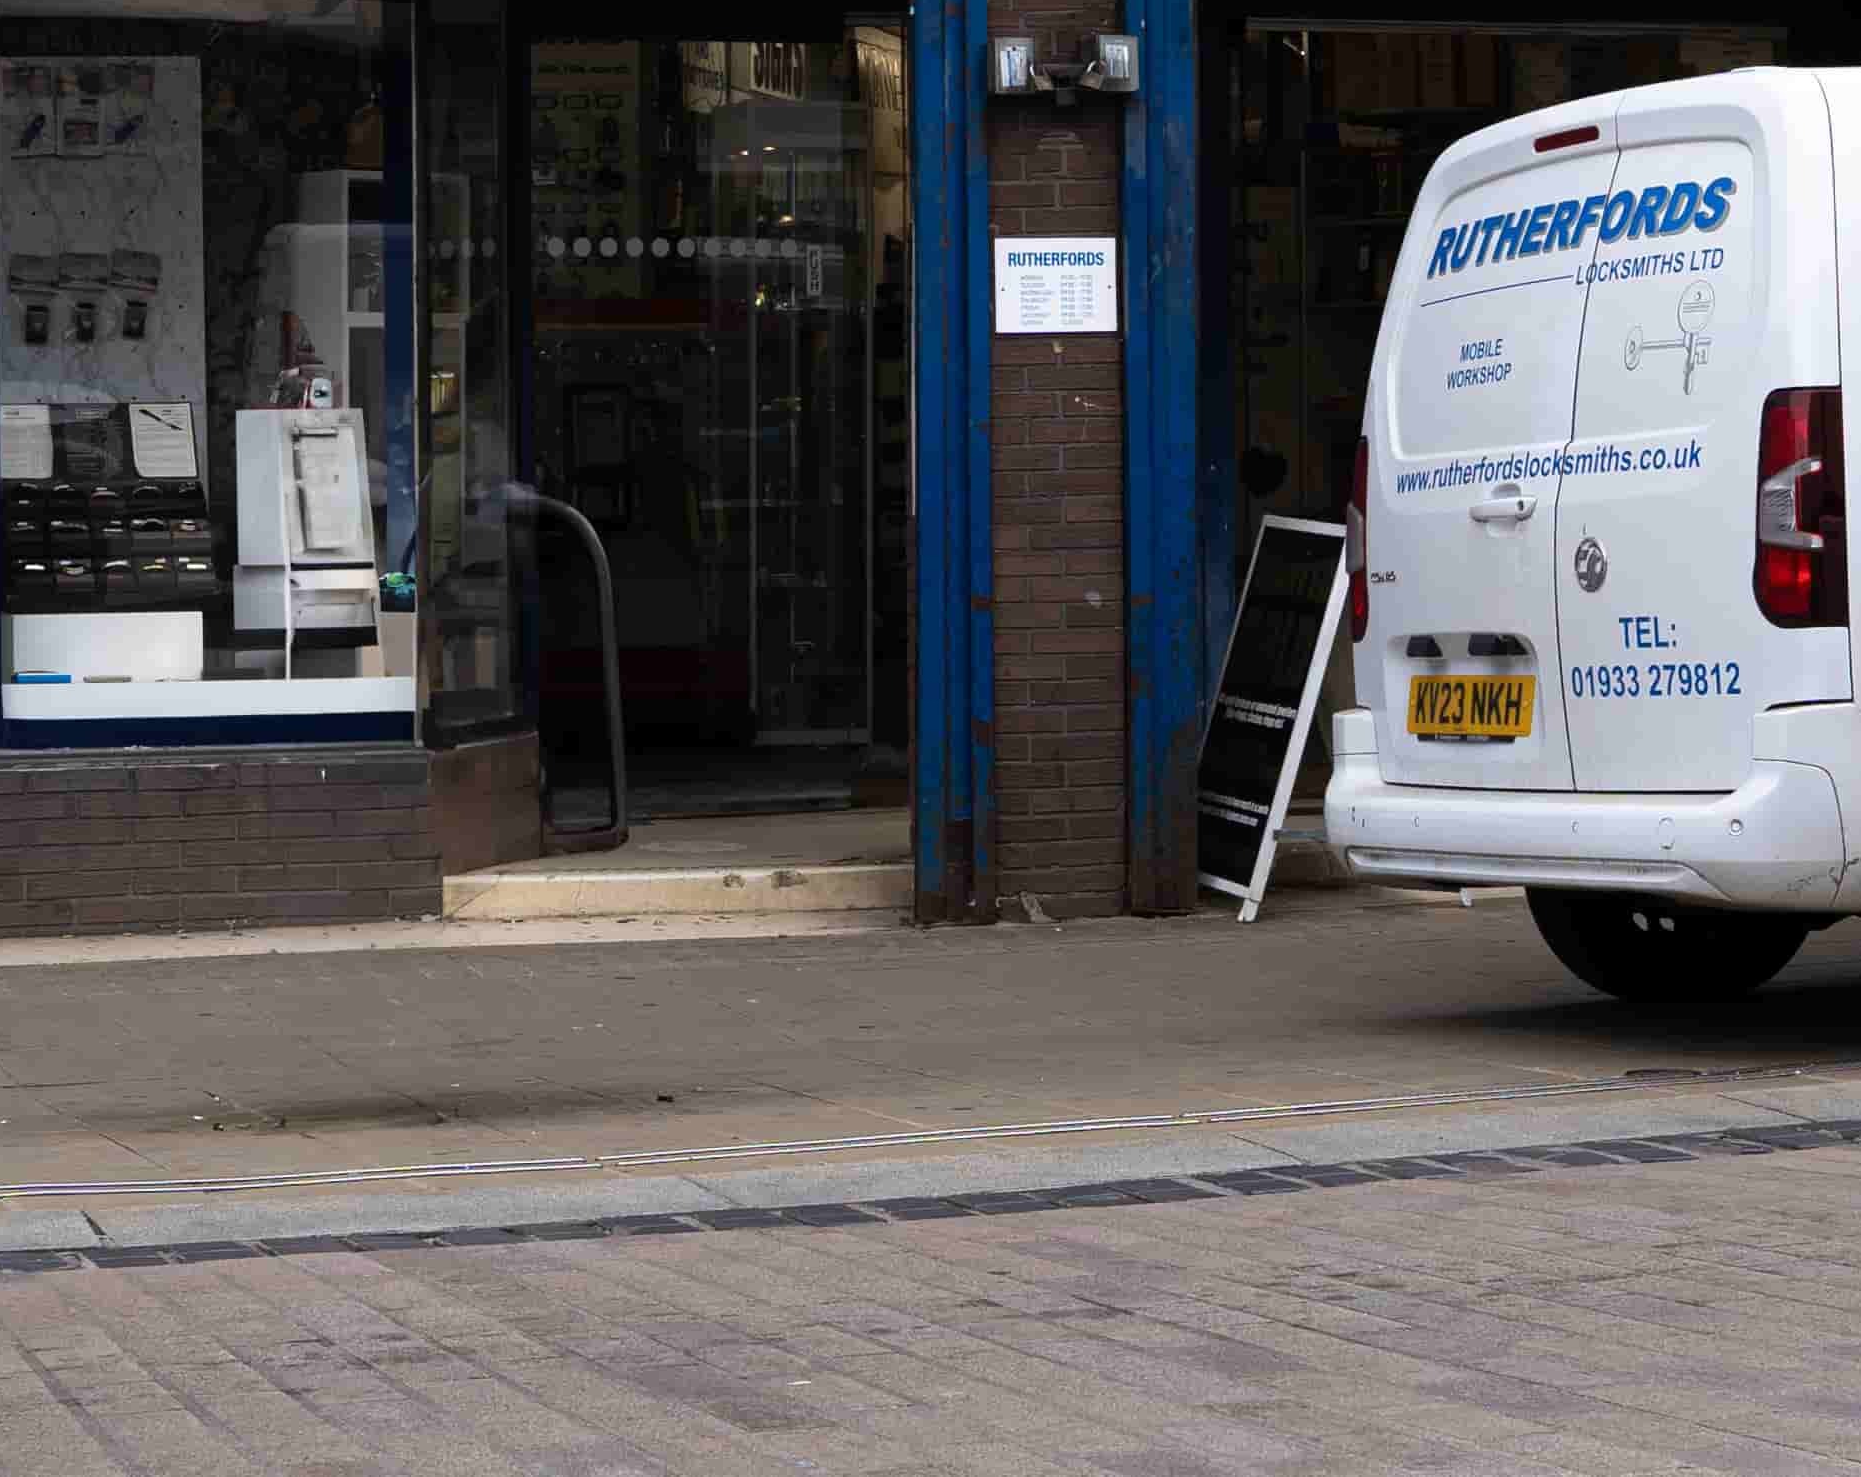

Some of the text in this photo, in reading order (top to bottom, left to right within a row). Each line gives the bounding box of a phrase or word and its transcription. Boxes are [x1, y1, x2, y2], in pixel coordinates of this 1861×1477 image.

[1427, 176, 1739, 280] RUTHERFORDS
[1007, 251, 1105, 267] RUTHERFORDS
[1575, 247, 1725, 286] LOCKSMITHS LTD
[1459, 338, 1503, 362] MOBILE
[1446, 363, 1513, 390] WORKSHOP
[1396, 439, 1703, 494] www.rutherfordslocksmiths.co.uk
[1619, 616, 1678, 649] TEL:
[1571, 662, 1741, 698] 01933 279812
[1414, 682, 1524, 726] KV23 NKH
